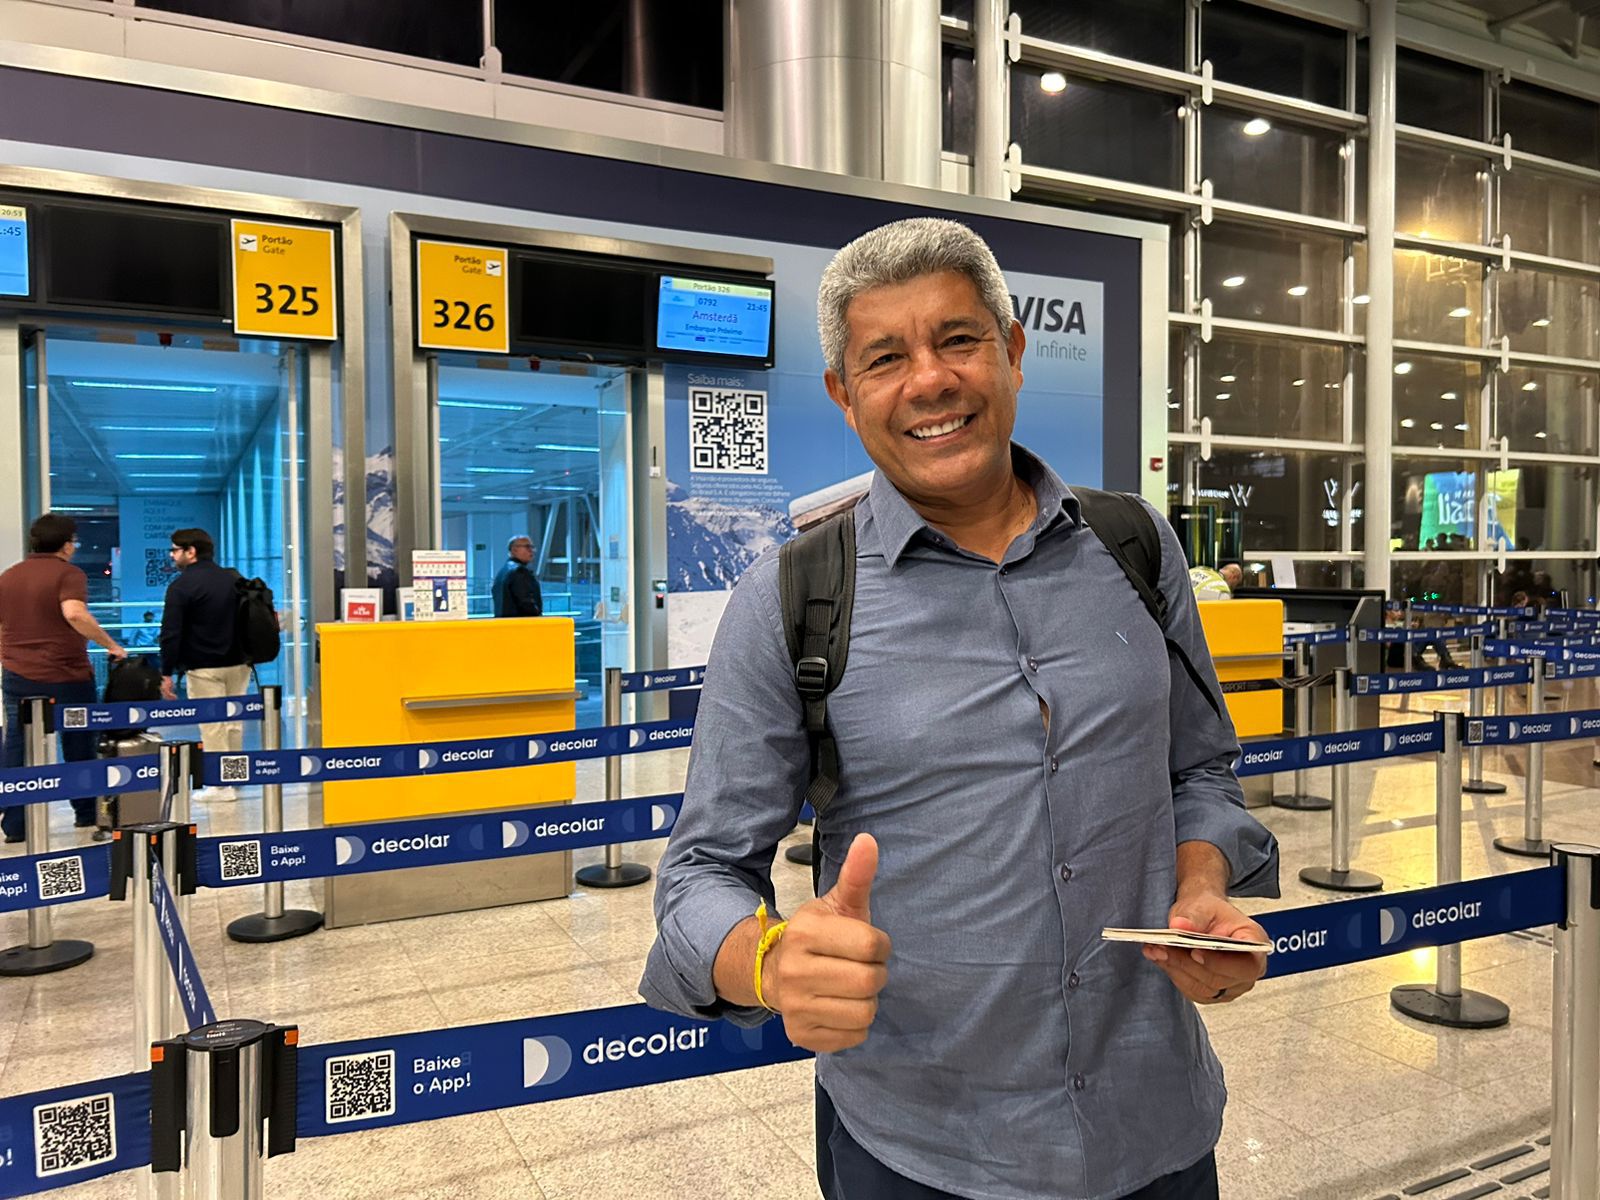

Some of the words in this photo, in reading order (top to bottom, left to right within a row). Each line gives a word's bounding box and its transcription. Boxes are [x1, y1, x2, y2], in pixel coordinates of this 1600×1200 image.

[0, 226, 21, 236] :45
[262, 234, 293, 245] Portão
[263, 245, 285, 255] Gate
[454, 255, 481, 265] Portão
[462, 265, 482, 274] Gate
[693, 282, 716, 292] Portão
[255, 283, 319, 316] 325
[698, 298, 718, 307] 0792
[433, 299, 495, 332] 326
[692, 310, 738, 324] Amsterdã
[1009, 295, 1086, 335] VISA
[1036, 340, 1087, 362] Infinite
[688, 373, 716, 385] Saiba
[717, 376, 744, 387] mais:
[150, 708, 197, 719] decolar
[1522, 723, 1552, 734] decolar
[325, 755, 382, 770] decolar
[442, 748, 495, 763] decolar
[550, 737, 598, 752] decolar
[649, 726, 693, 741] decolar
[1244, 749, 1284, 764] decolar
[1324, 739, 1361, 754] decolar
[1398, 731, 1433, 745] decolar
[372, 833, 450, 855] decolar
[535, 816, 605, 838] decolar
[270, 844, 300, 855] Baixe
[270, 858, 278, 866] o
[280, 855, 306, 869] App!
[1412, 901, 1482, 929] decolar
[582, 1026, 710, 1065] decolar
[413, 1053, 462, 1074] Baixe
[413, 1083, 425, 1094] o
[428, 1072, 472, 1093] App!
